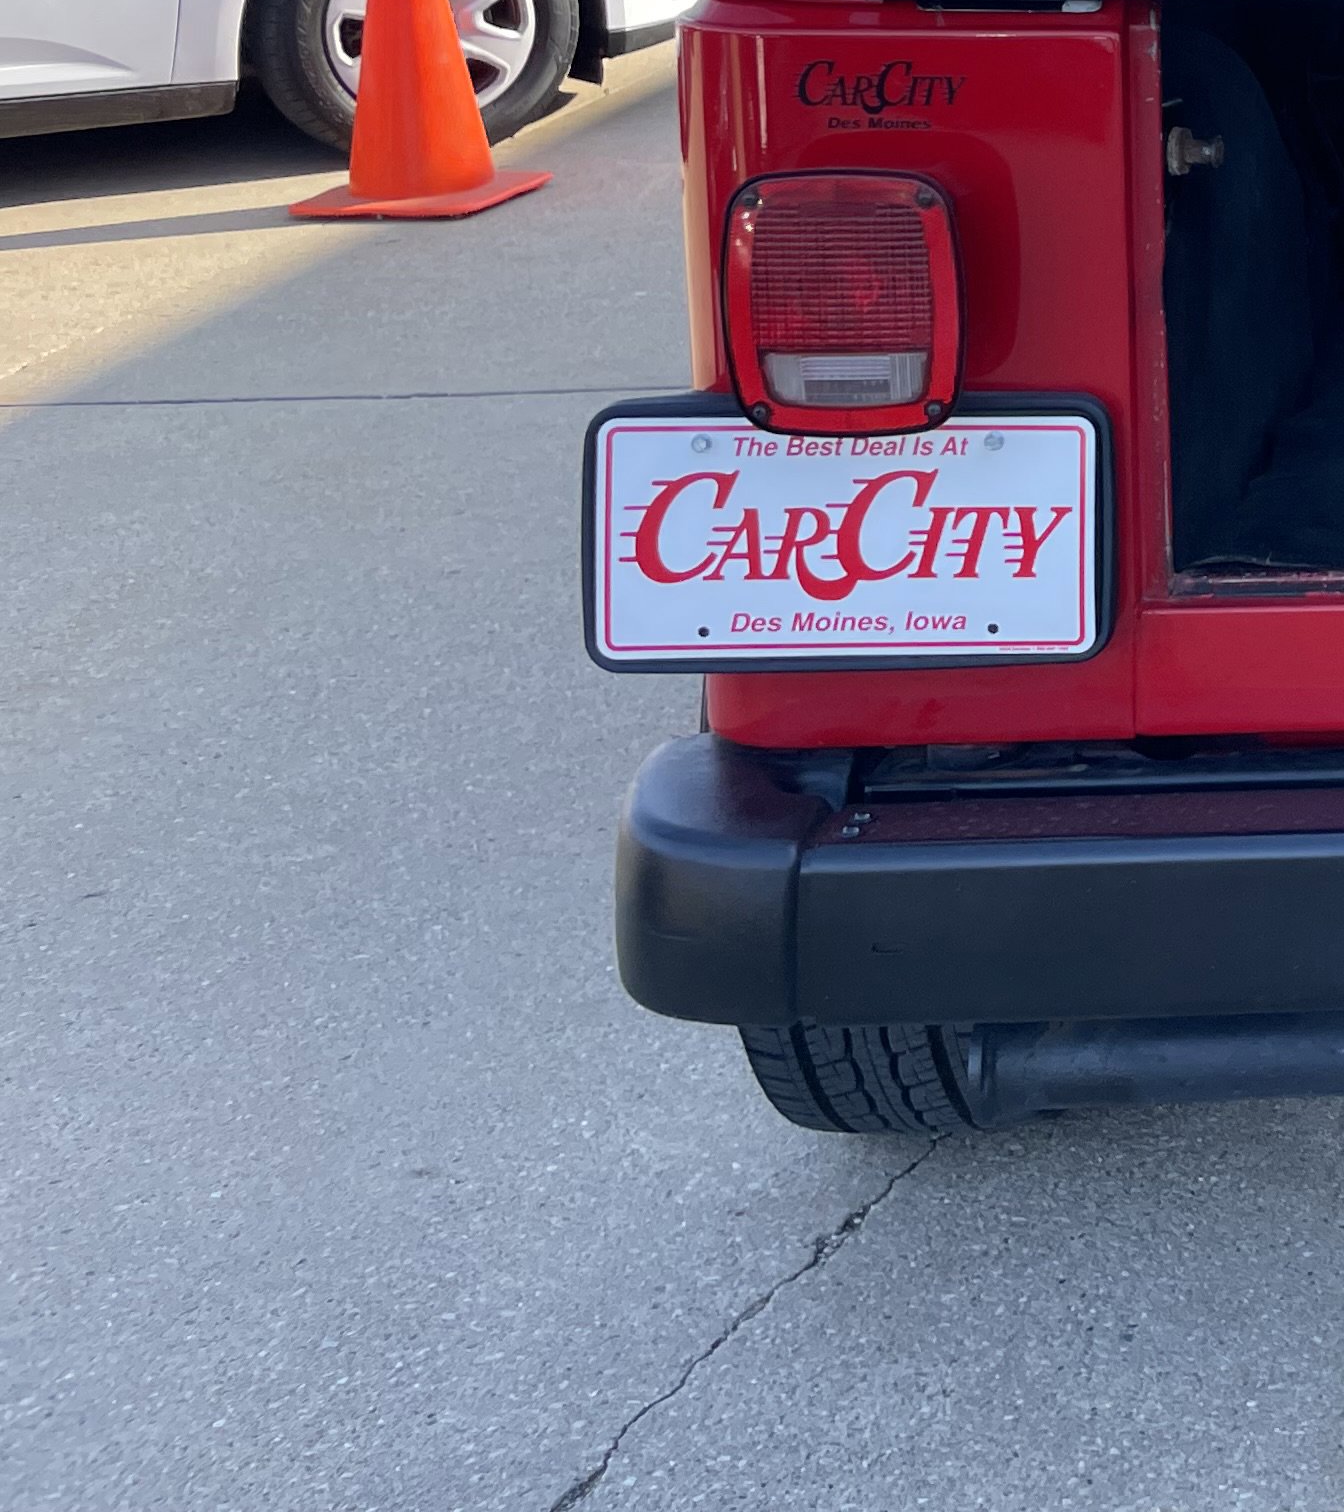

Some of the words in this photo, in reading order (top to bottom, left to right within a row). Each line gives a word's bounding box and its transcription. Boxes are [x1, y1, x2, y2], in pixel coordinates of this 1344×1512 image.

[827, 116, 861, 129] Des
[868, 117, 932, 129] Moines
[733, 436, 778, 457] The
[786, 435, 843, 457] Best
[850, 435, 905, 457] Deal
[912, 436, 933, 456] Is
[939, 436, 969, 456] At
[730, 612, 782, 633] Des
[790, 611, 895, 635] Moines,
[905, 610, 967, 631] Iowa
